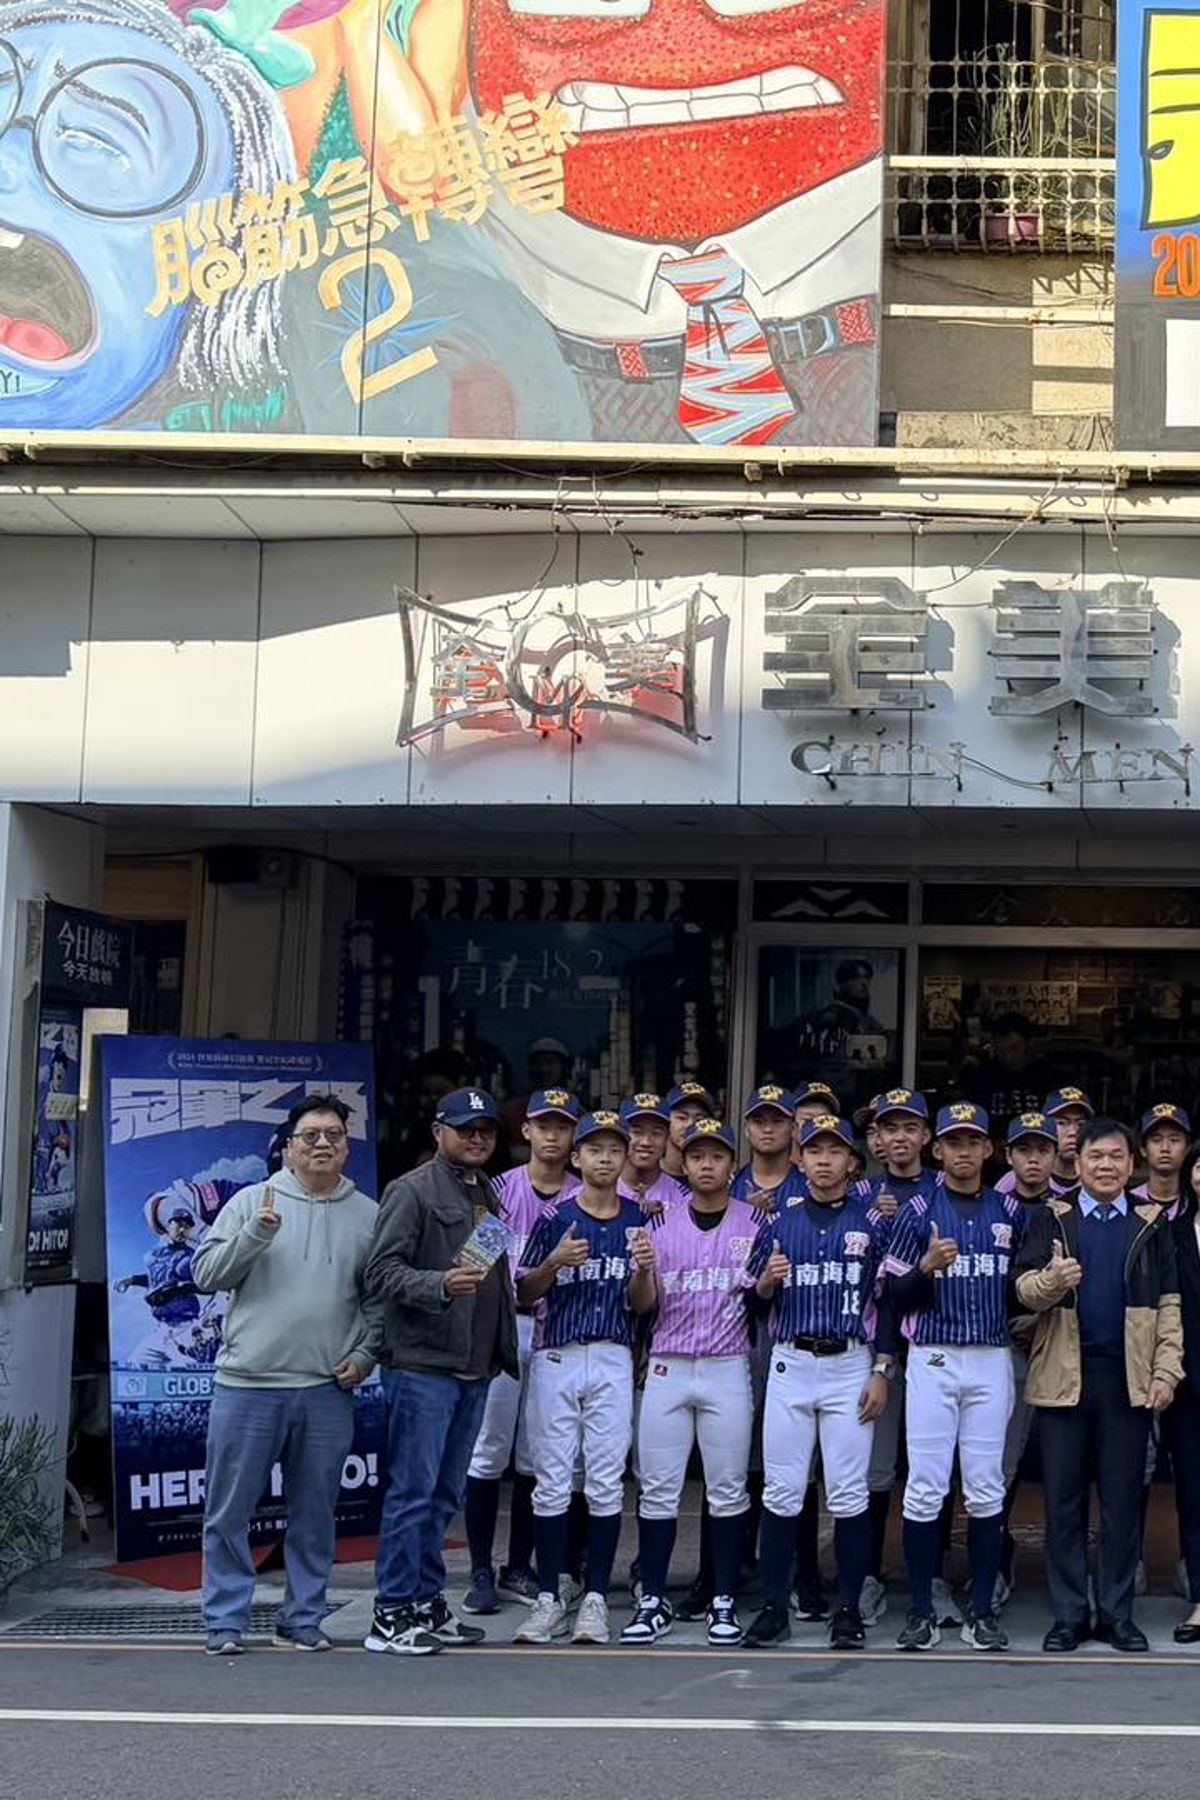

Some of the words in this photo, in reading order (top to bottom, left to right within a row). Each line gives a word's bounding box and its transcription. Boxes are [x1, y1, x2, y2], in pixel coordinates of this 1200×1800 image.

[318, 247, 439, 403] 2
[790, 739, 967, 781] CHIN
[1046, 743, 1193, 784] MEN
[468, 1092, 485, 1110] LA
[163, 1376, 213, 1397] GLOB
[130, 1469, 208, 1511] HER
